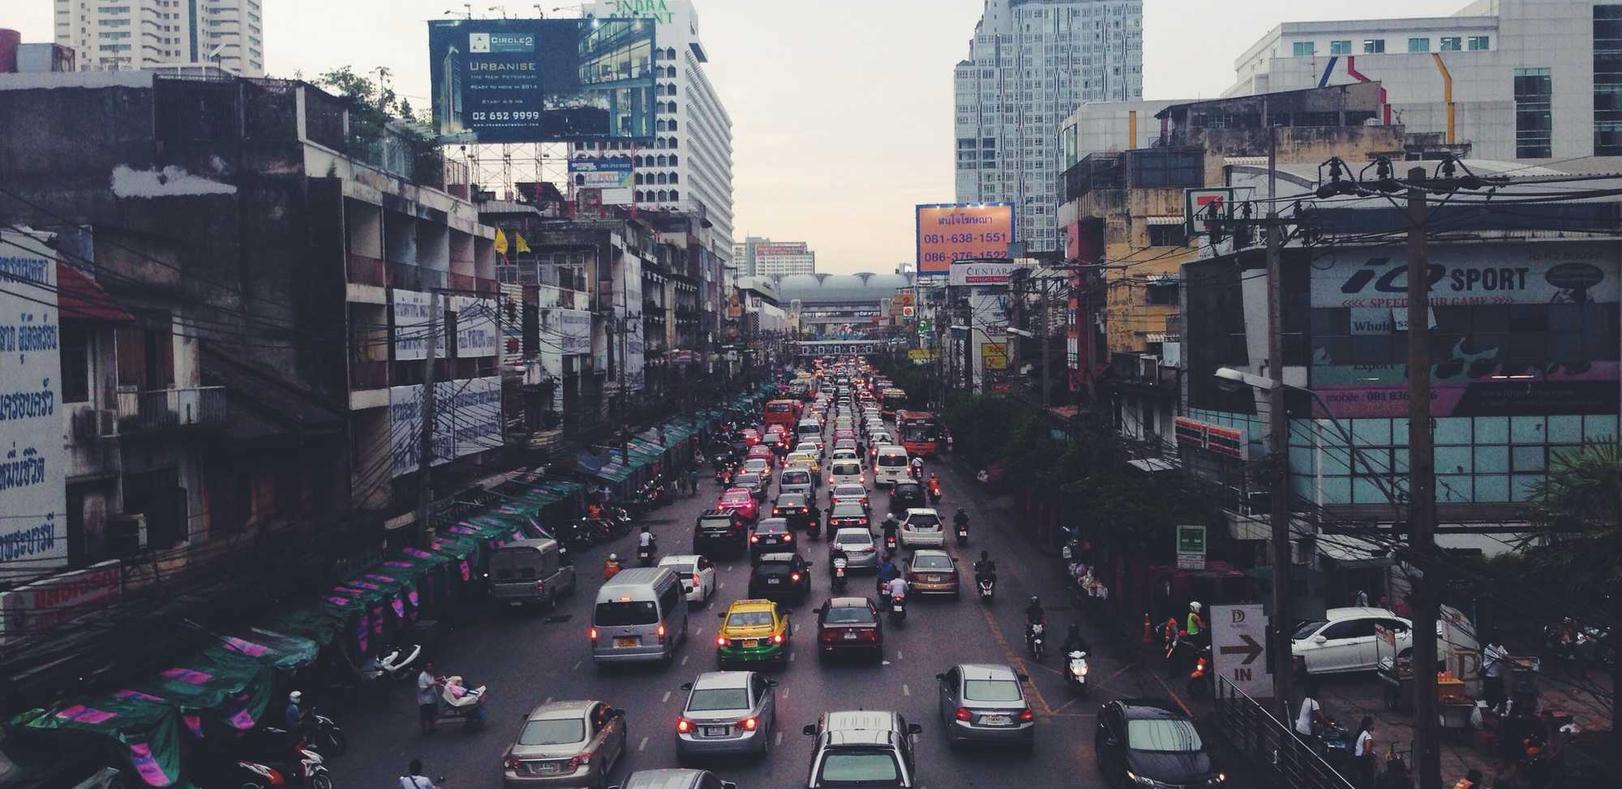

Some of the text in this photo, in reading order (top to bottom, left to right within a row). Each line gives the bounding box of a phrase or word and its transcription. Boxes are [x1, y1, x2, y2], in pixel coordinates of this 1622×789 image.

[470, 61, 536, 71] URBANISE
[472, 111, 540, 121] 02 652 9999
[924, 232, 1007, 244] 081-638-1551
[1450, 266, 1530, 292] SPORT
[1234, 668, 1252, 682] IN
